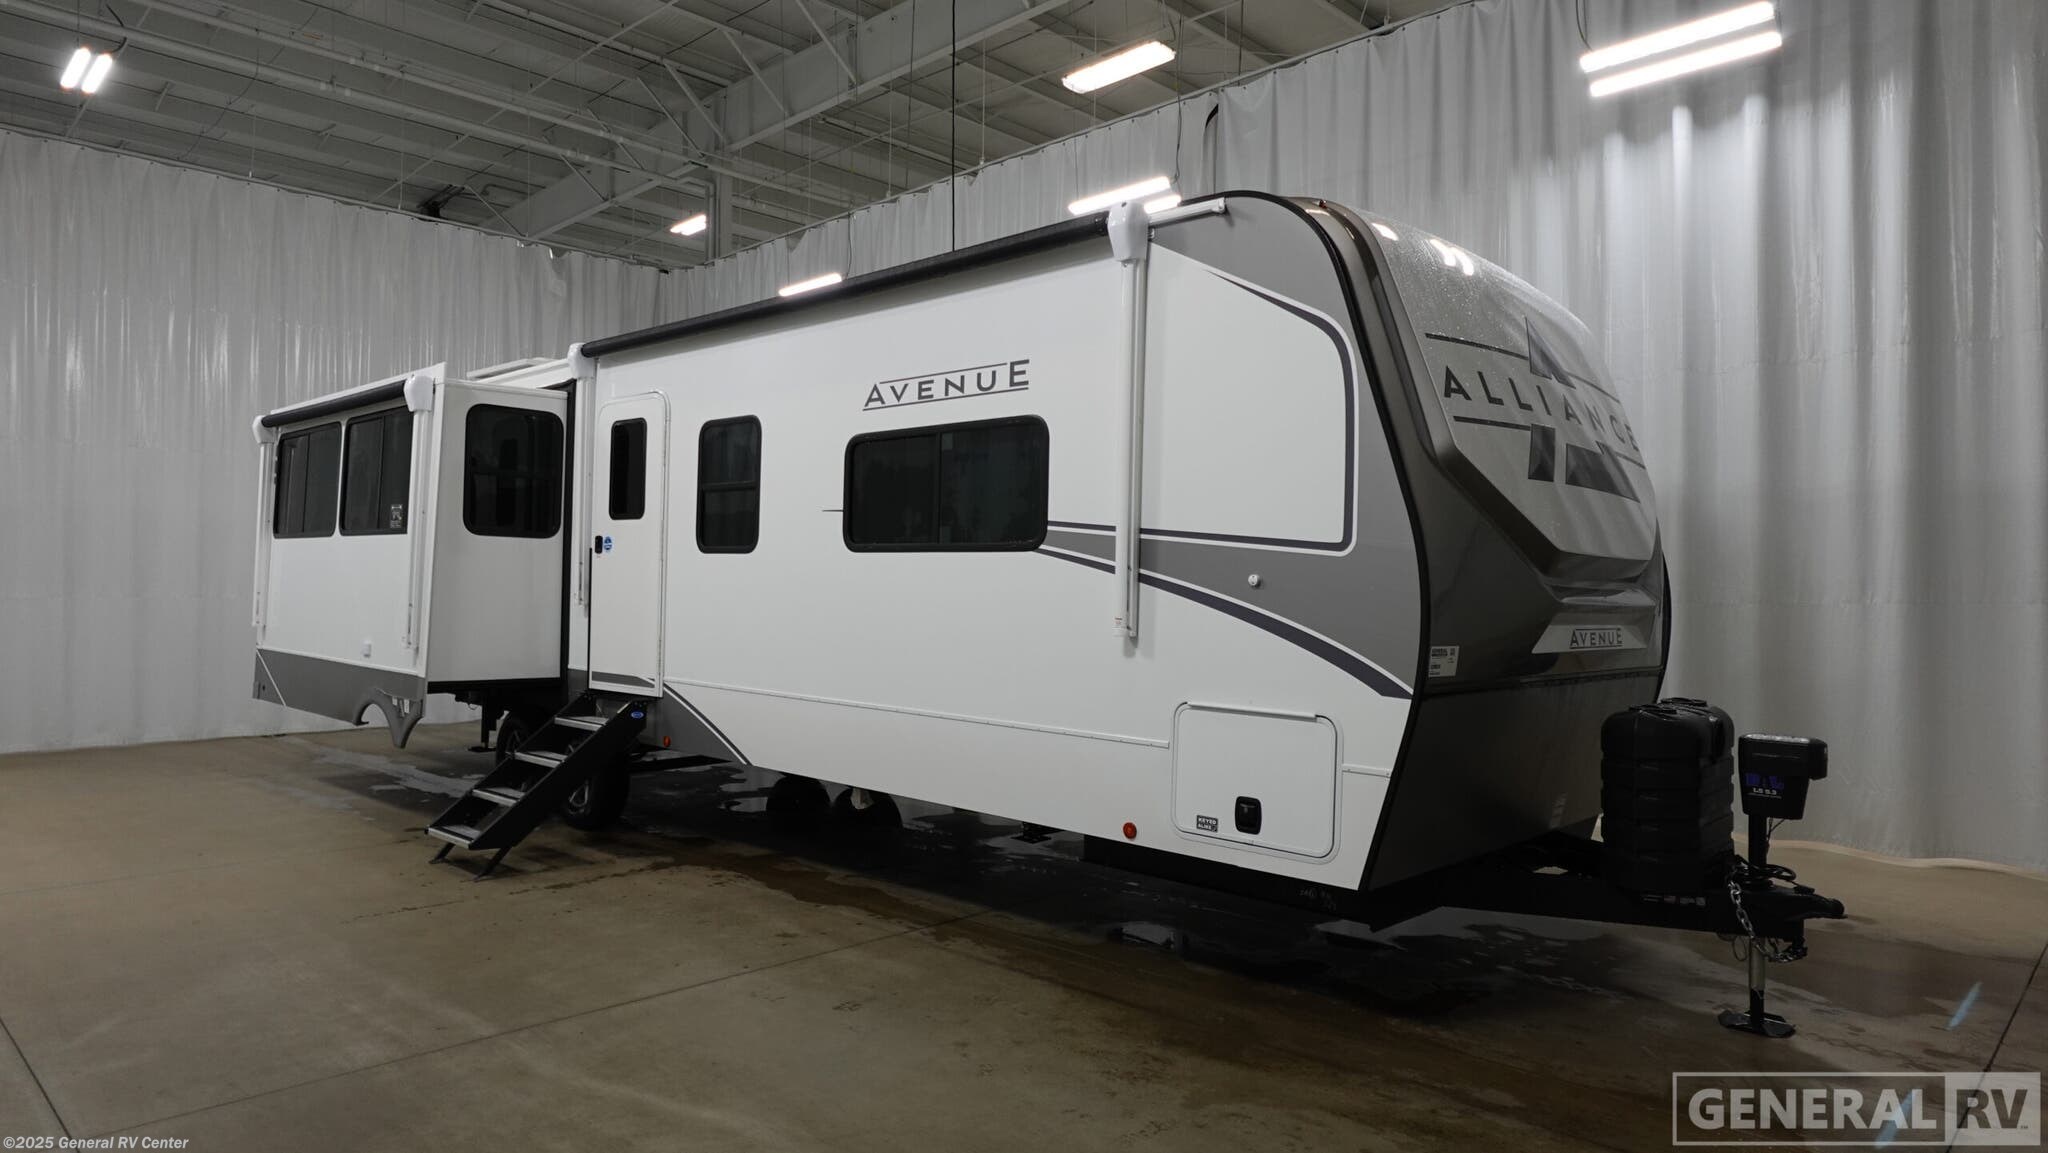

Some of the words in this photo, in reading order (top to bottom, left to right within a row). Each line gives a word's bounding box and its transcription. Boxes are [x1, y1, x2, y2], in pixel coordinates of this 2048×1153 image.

[864, 359, 1030, 408] AVENUE
[1444, 365, 1640, 452] ALLIANCE
[1570, 628, 1622, 647] AVENUE
[1198, 817, 1217, 825] KEYED
